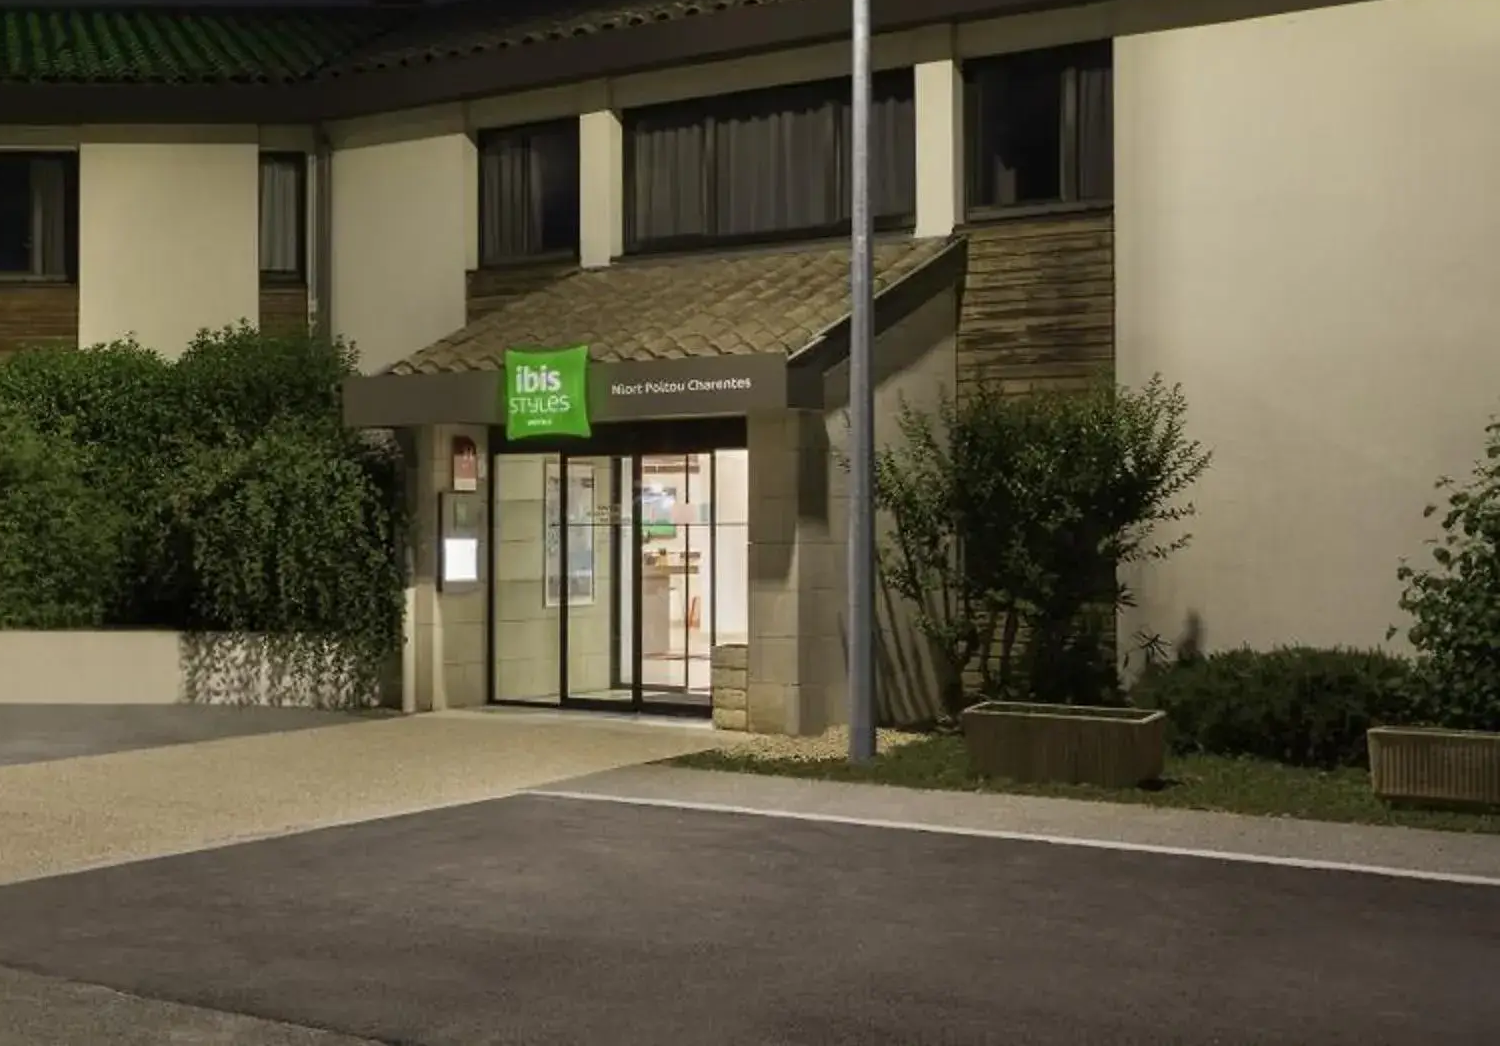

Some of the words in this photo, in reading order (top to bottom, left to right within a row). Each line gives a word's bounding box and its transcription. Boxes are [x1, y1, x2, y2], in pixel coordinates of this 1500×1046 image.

[515, 364, 561, 394] ibis
[611, 383, 643, 395] Niort
[645, 381, 685, 394] Poitou
[687, 377, 752, 392] Charentes
